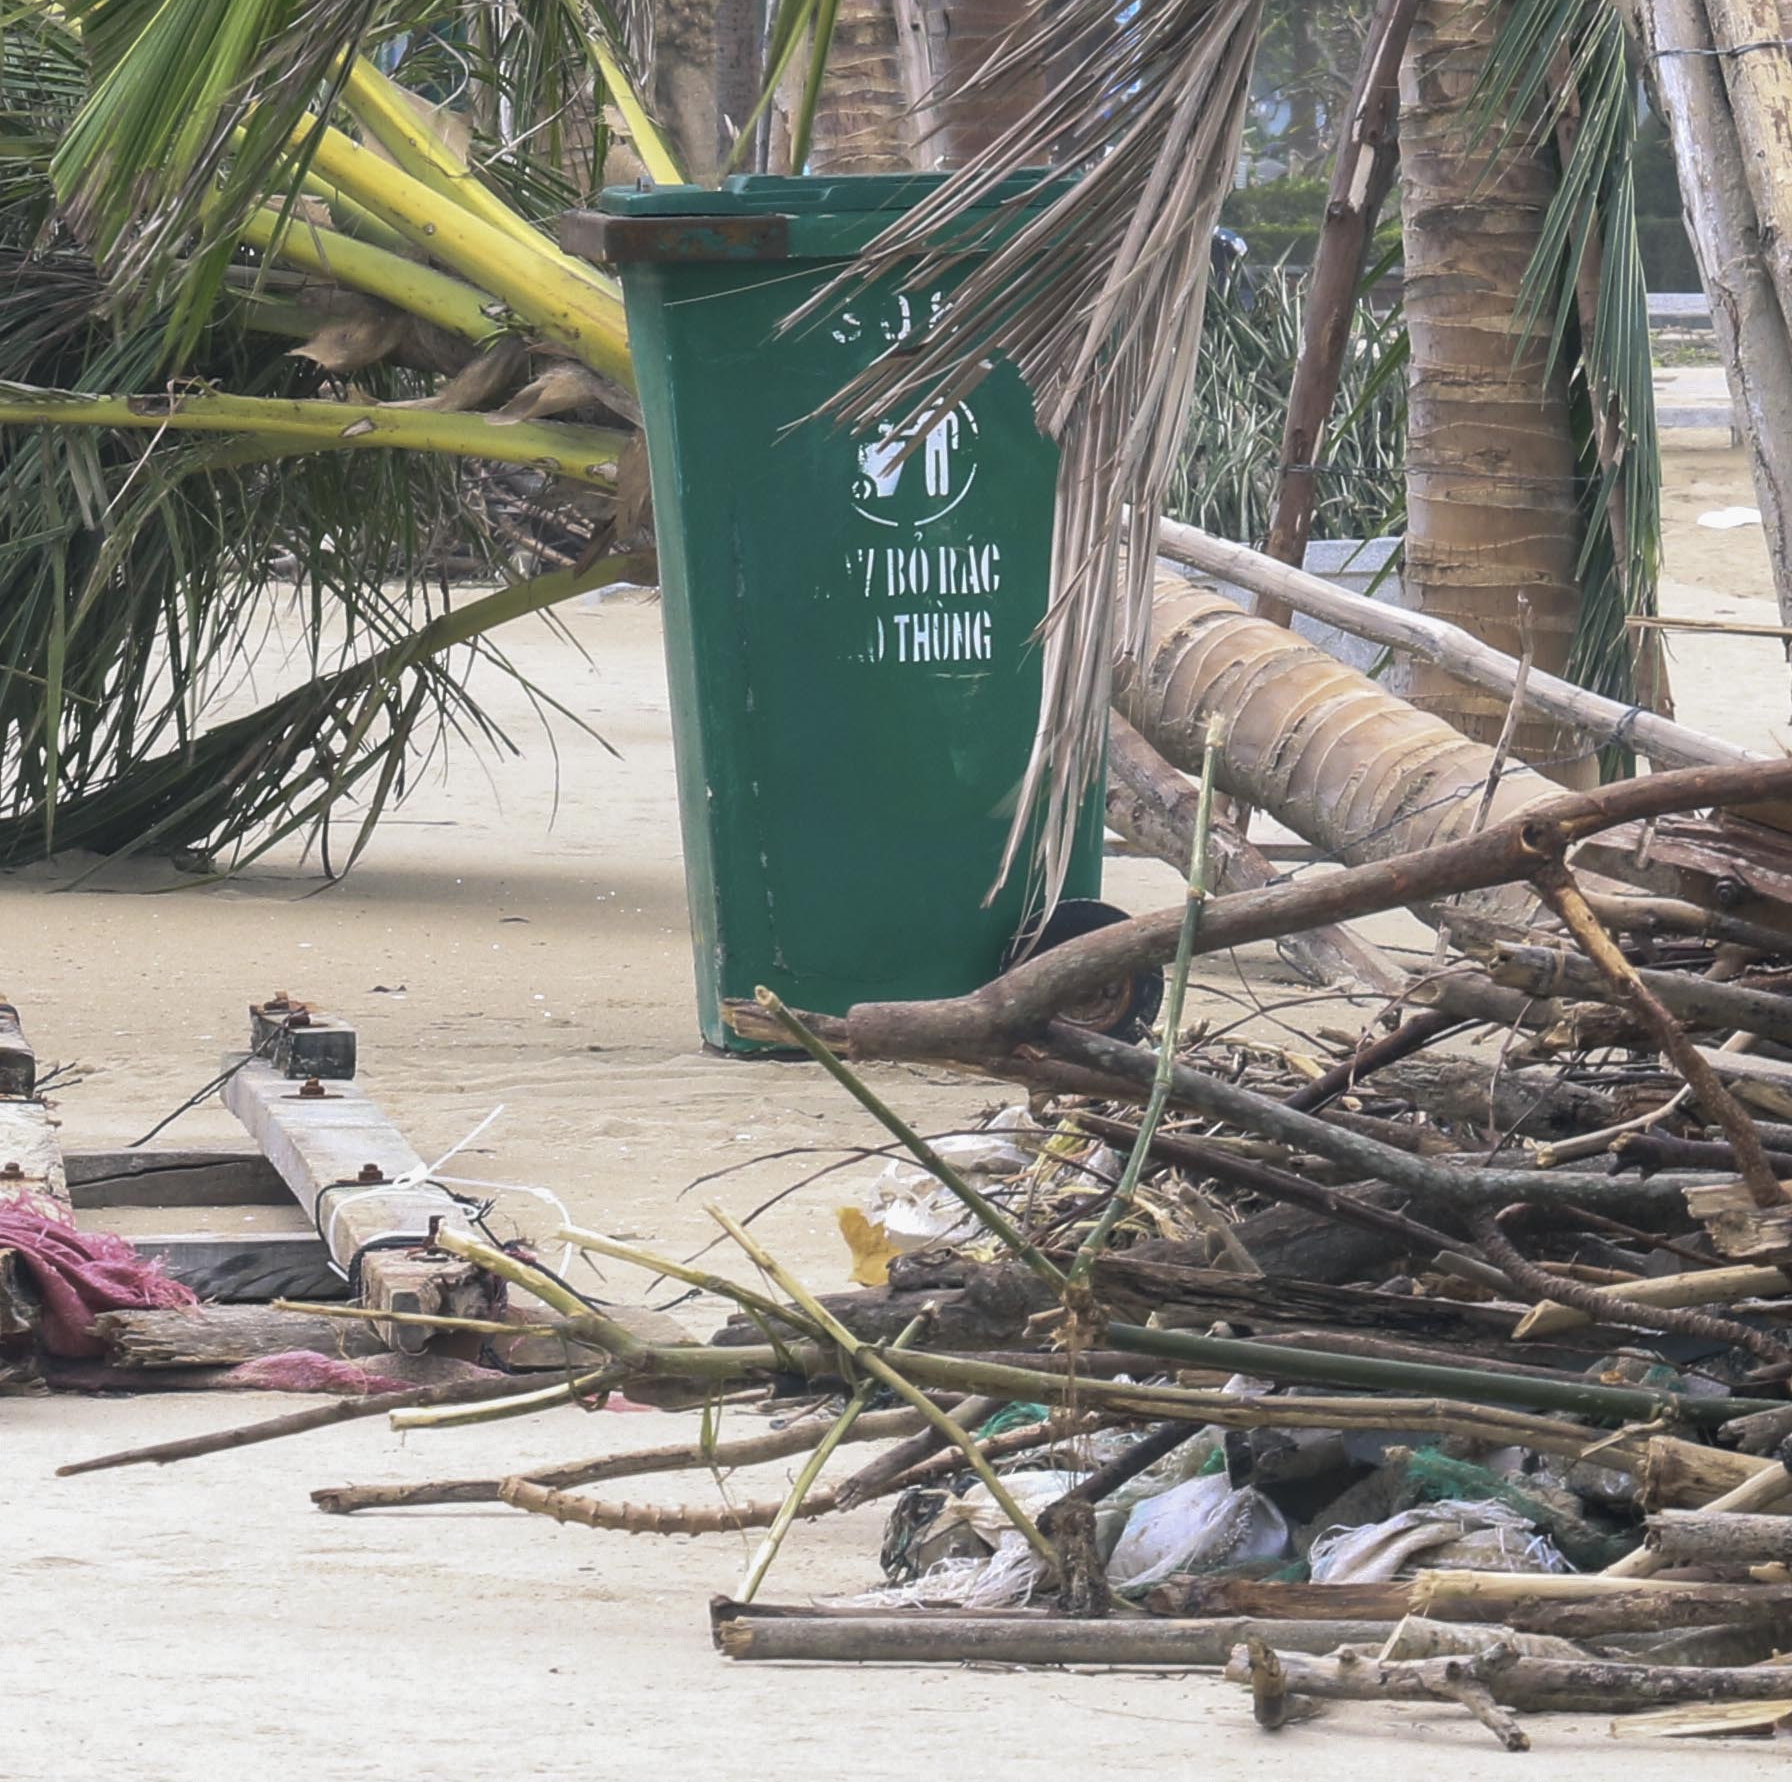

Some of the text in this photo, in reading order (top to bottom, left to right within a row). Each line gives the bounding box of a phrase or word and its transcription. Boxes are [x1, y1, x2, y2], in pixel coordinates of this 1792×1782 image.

[886, 531, 929, 596] BỎ
[939, 534, 1000, 595] RÁC
[894, 600, 992, 662] THÙNG
